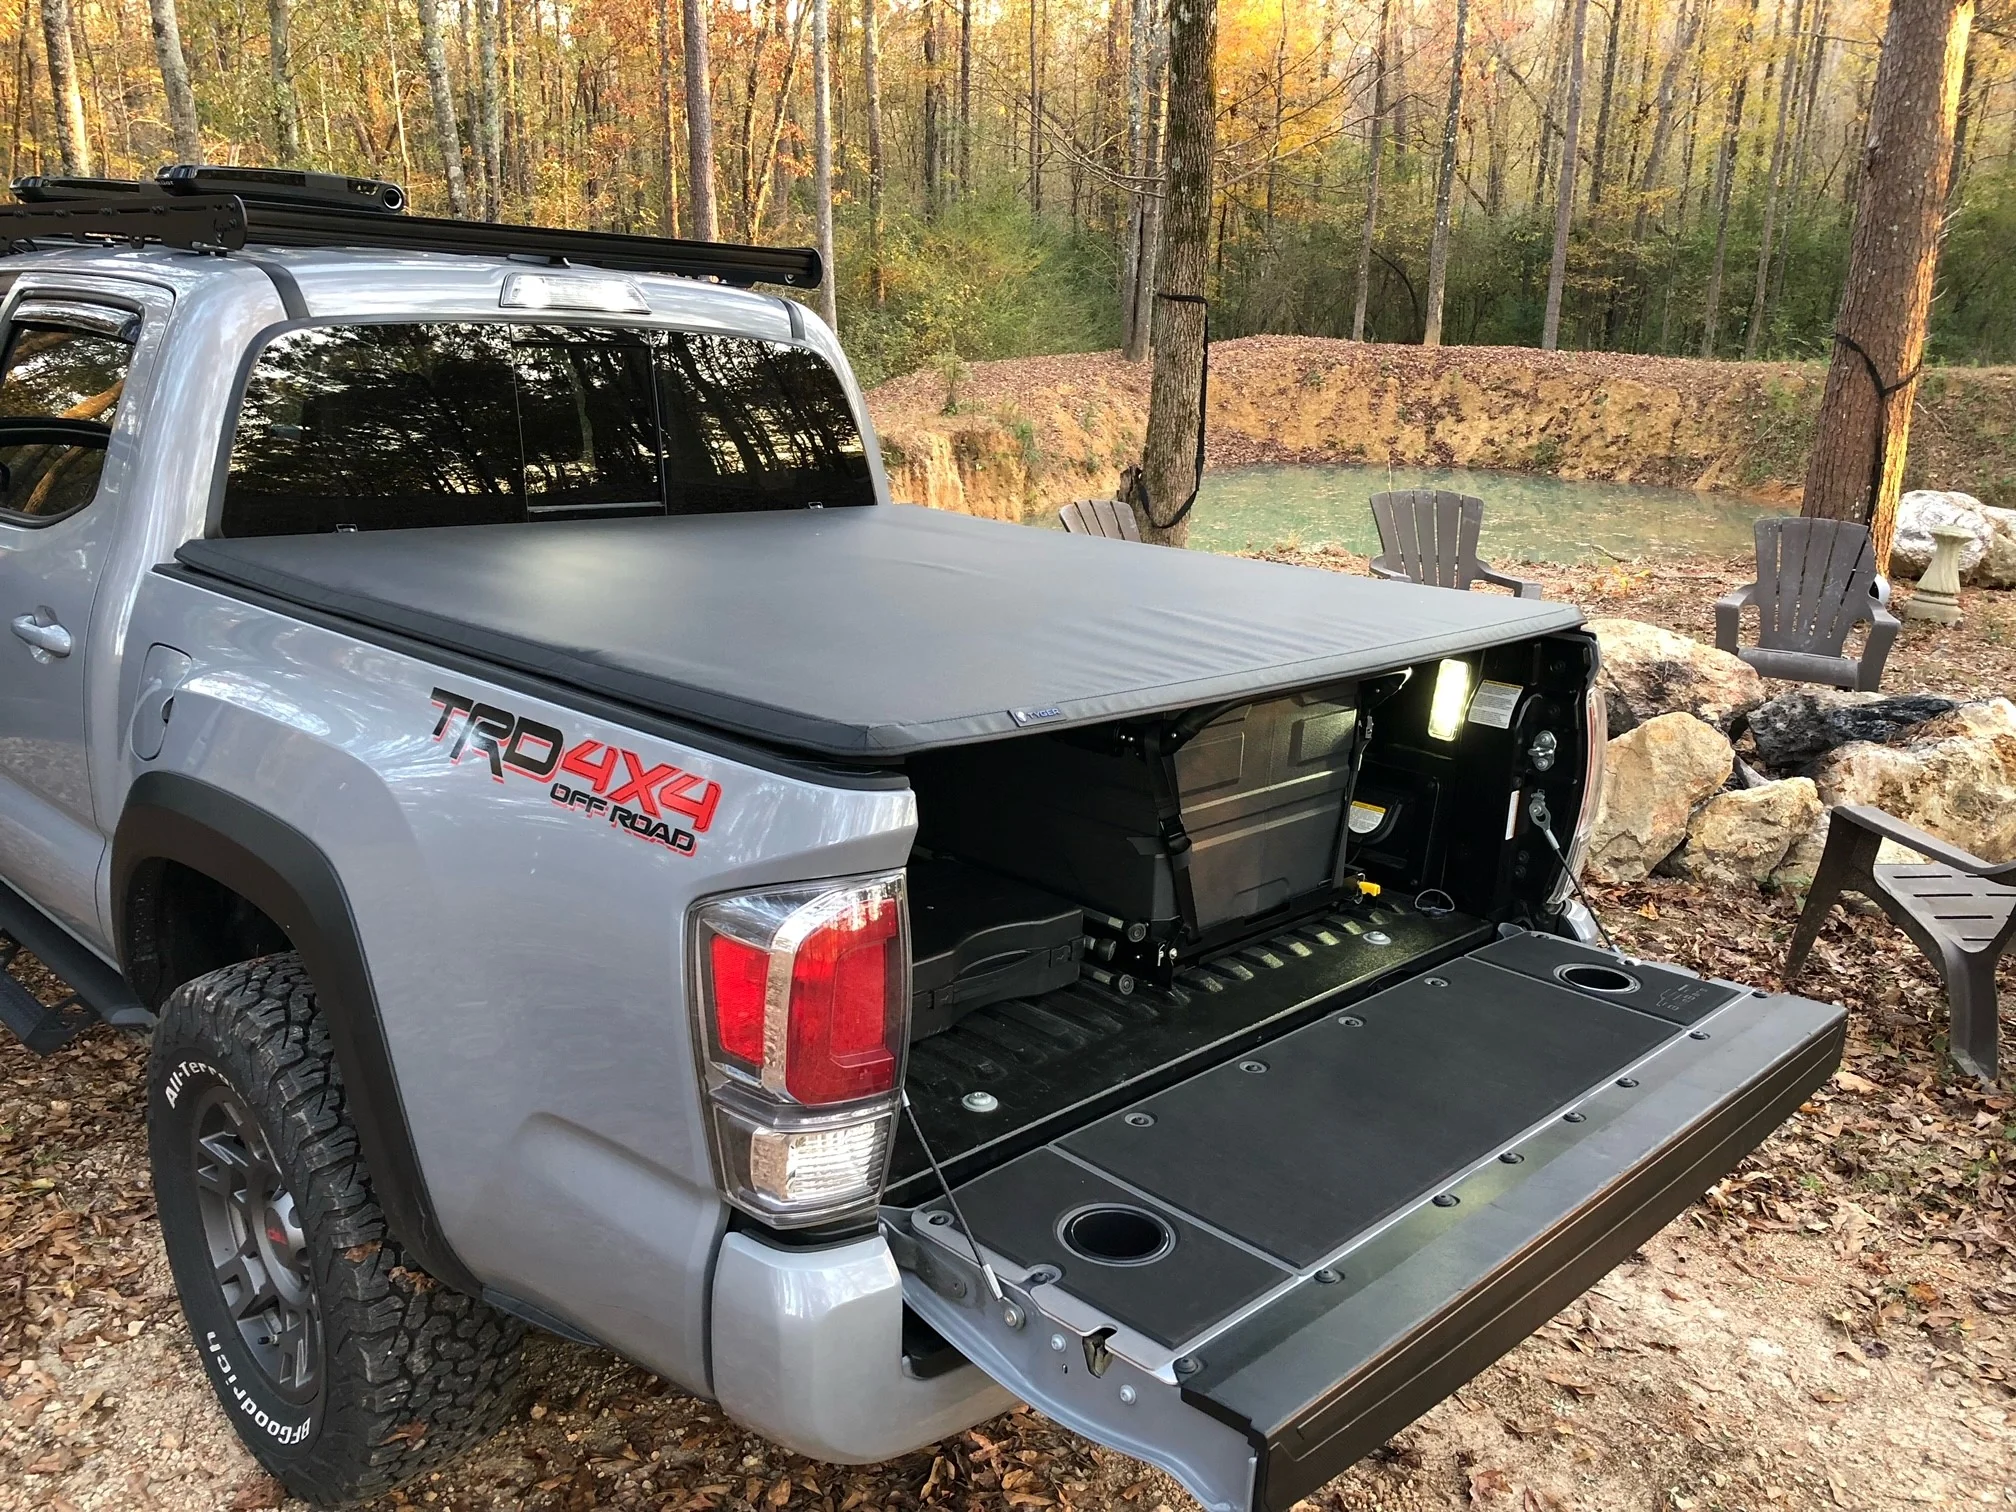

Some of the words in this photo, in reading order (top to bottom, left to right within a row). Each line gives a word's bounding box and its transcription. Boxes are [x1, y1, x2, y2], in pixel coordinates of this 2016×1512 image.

[1027, 708, 1060, 719] TYGER
[430, 687, 564, 784] TRD
[561, 739, 722, 832] 4X4
[549, 783, 608, 817] OFF
[609, 805, 697, 857] ROAD
